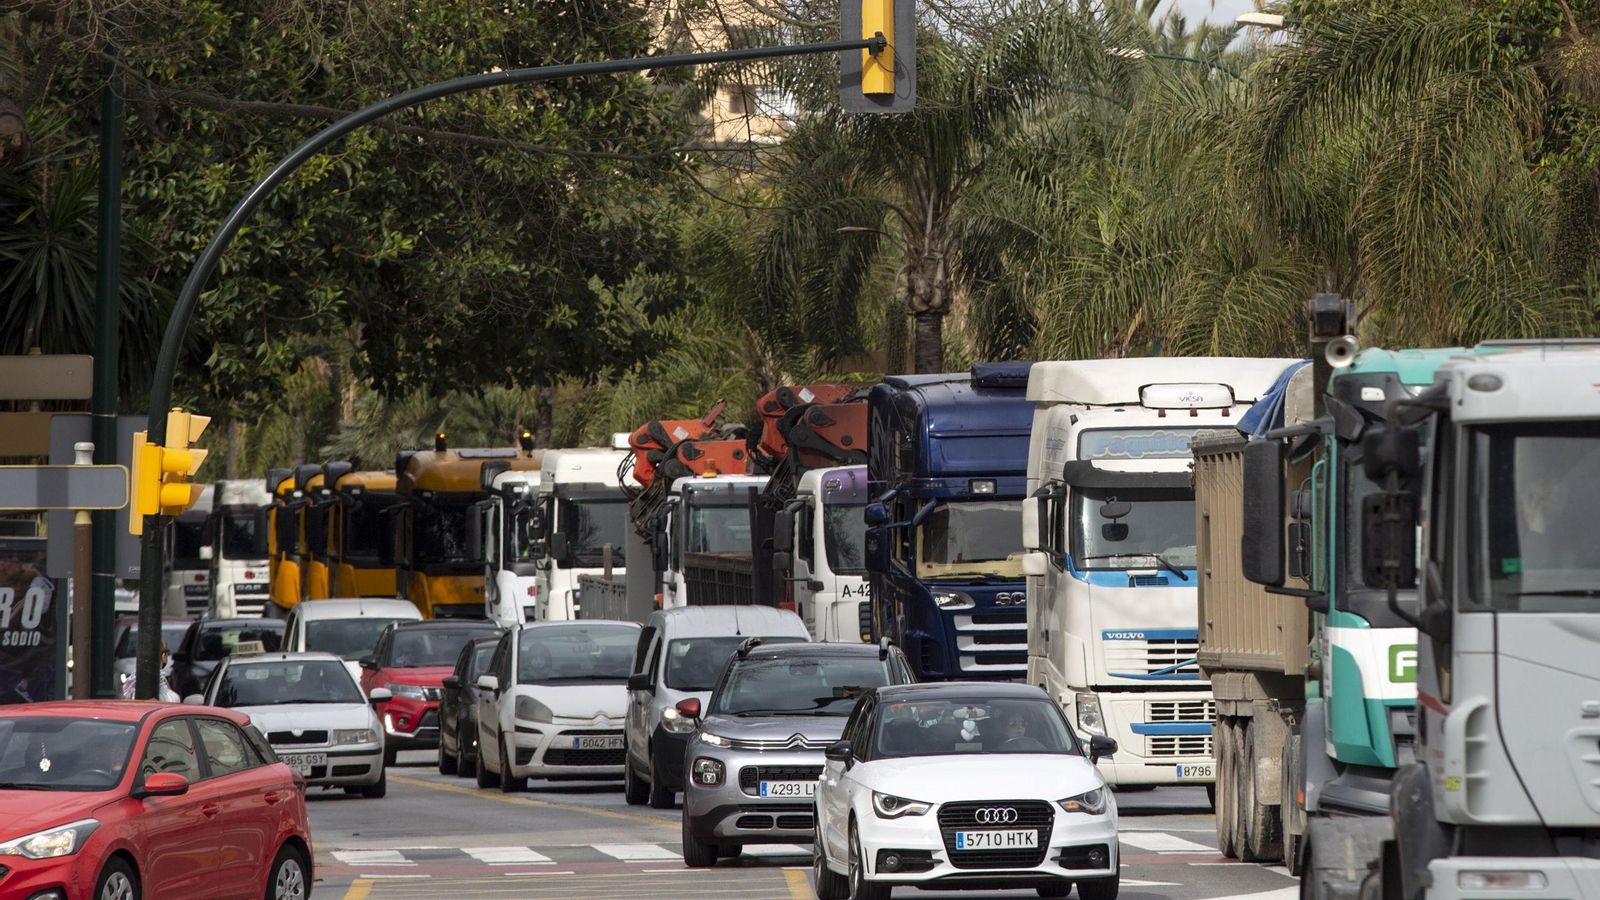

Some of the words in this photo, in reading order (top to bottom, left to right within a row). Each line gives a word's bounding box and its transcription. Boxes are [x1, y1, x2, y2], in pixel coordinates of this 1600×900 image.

[2, 631, 41, 646] SODIO
[582, 738, 606, 748] 6042
[1183, 766, 1212, 777] 8796
[771, 783, 801, 796] 4293
[966, 832, 1002, 847] 5710
[1007, 831, 1034, 846] HTK
